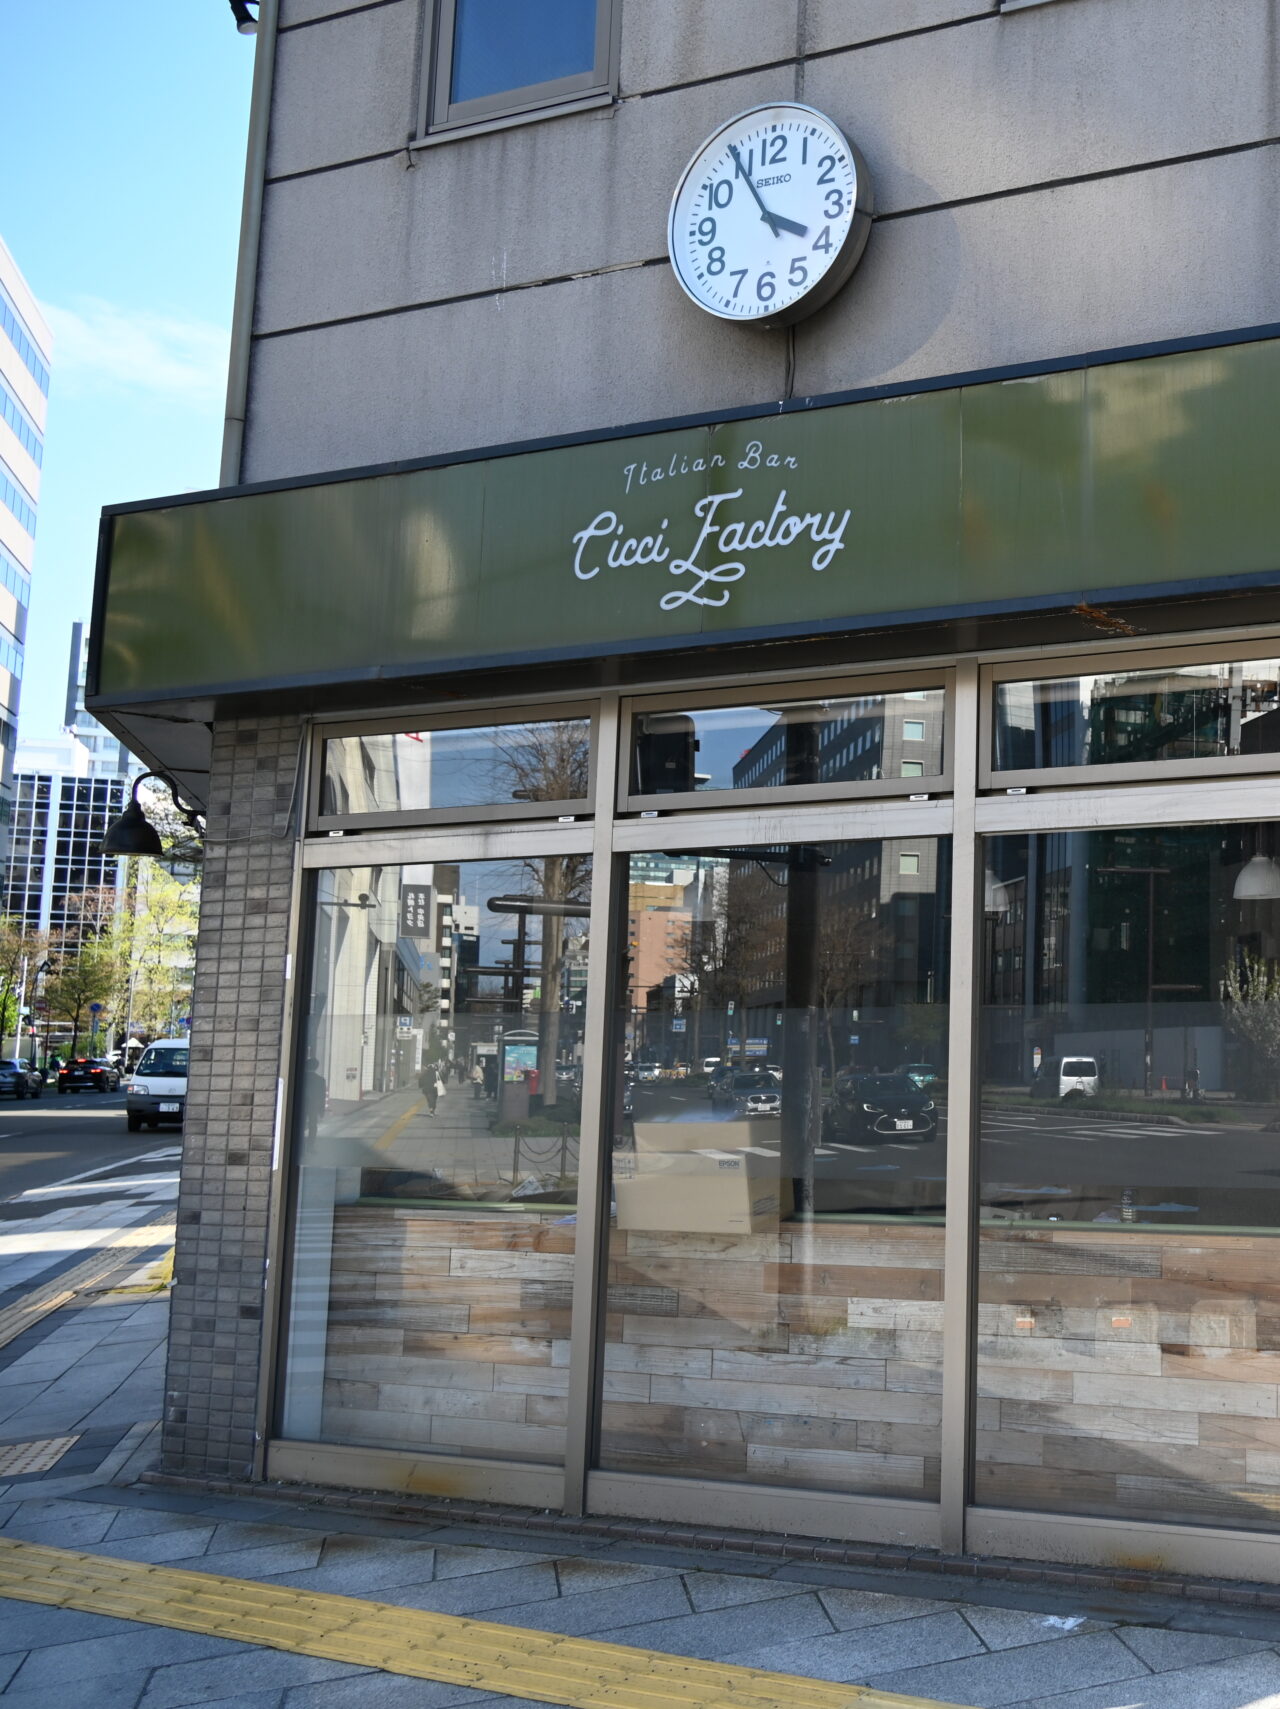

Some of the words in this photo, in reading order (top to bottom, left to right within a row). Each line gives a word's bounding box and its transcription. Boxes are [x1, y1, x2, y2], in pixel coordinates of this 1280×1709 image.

[761, 134, 787, 166] 12
[802, 137, 807, 164] 1
[756, 173, 792, 188] SEIKO
[817, 156, 836, 186] 2
[708, 180, 733, 210] 10
[823, 189, 844, 219] 3
[698, 217, 717, 246] 9
[812, 225, 832, 255] 4
[707, 247, 725, 276] 8
[788, 256, 808, 287] 5
[730, 269, 748, 298] 7
[756, 272, 776, 301] 6
[624, 452, 726, 494] Italian
[738, 440, 799, 470] Bar
[572, 510, 670, 580] Cicci
[659, 487, 852, 611] Factory
[718, 1159, 740, 1167] EPSON
